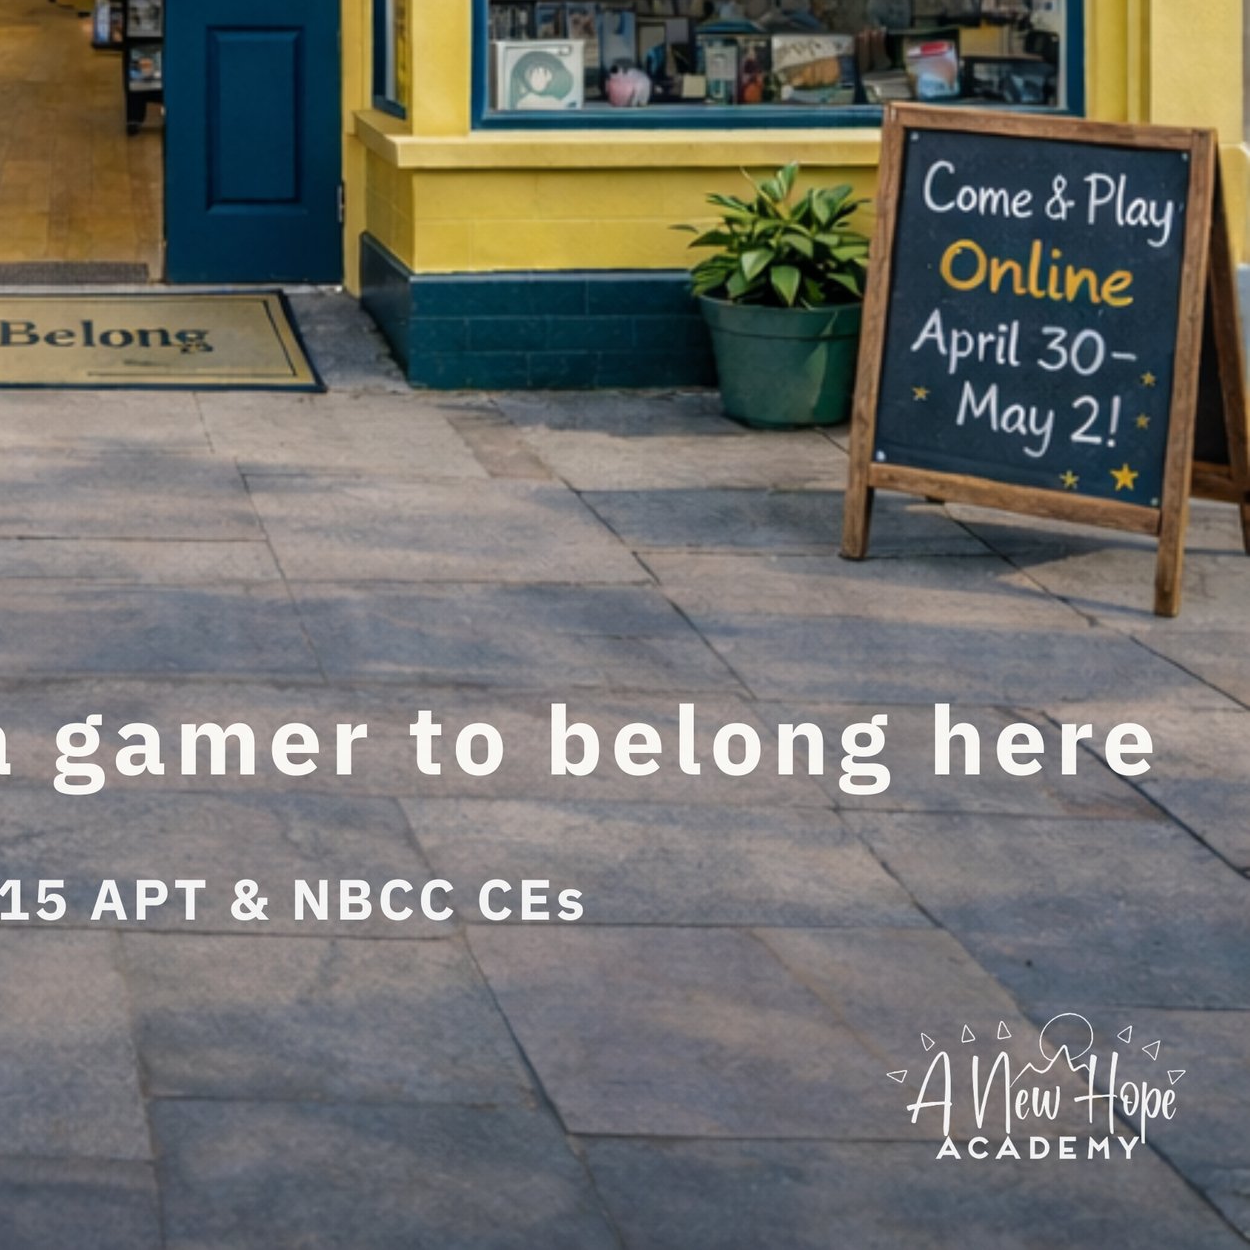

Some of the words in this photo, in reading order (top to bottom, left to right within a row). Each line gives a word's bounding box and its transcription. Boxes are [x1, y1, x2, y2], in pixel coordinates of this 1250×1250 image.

[923, 160, 1033, 219] Come
[1045, 174, 1075, 221] &
[1083, 172, 1175, 248] Play
[939, 238, 1135, 307] Online
[910, 308, 1021, 375] April
[955, 381, 1056, 458] May
[1070, 395, 1122, 448] 2!
